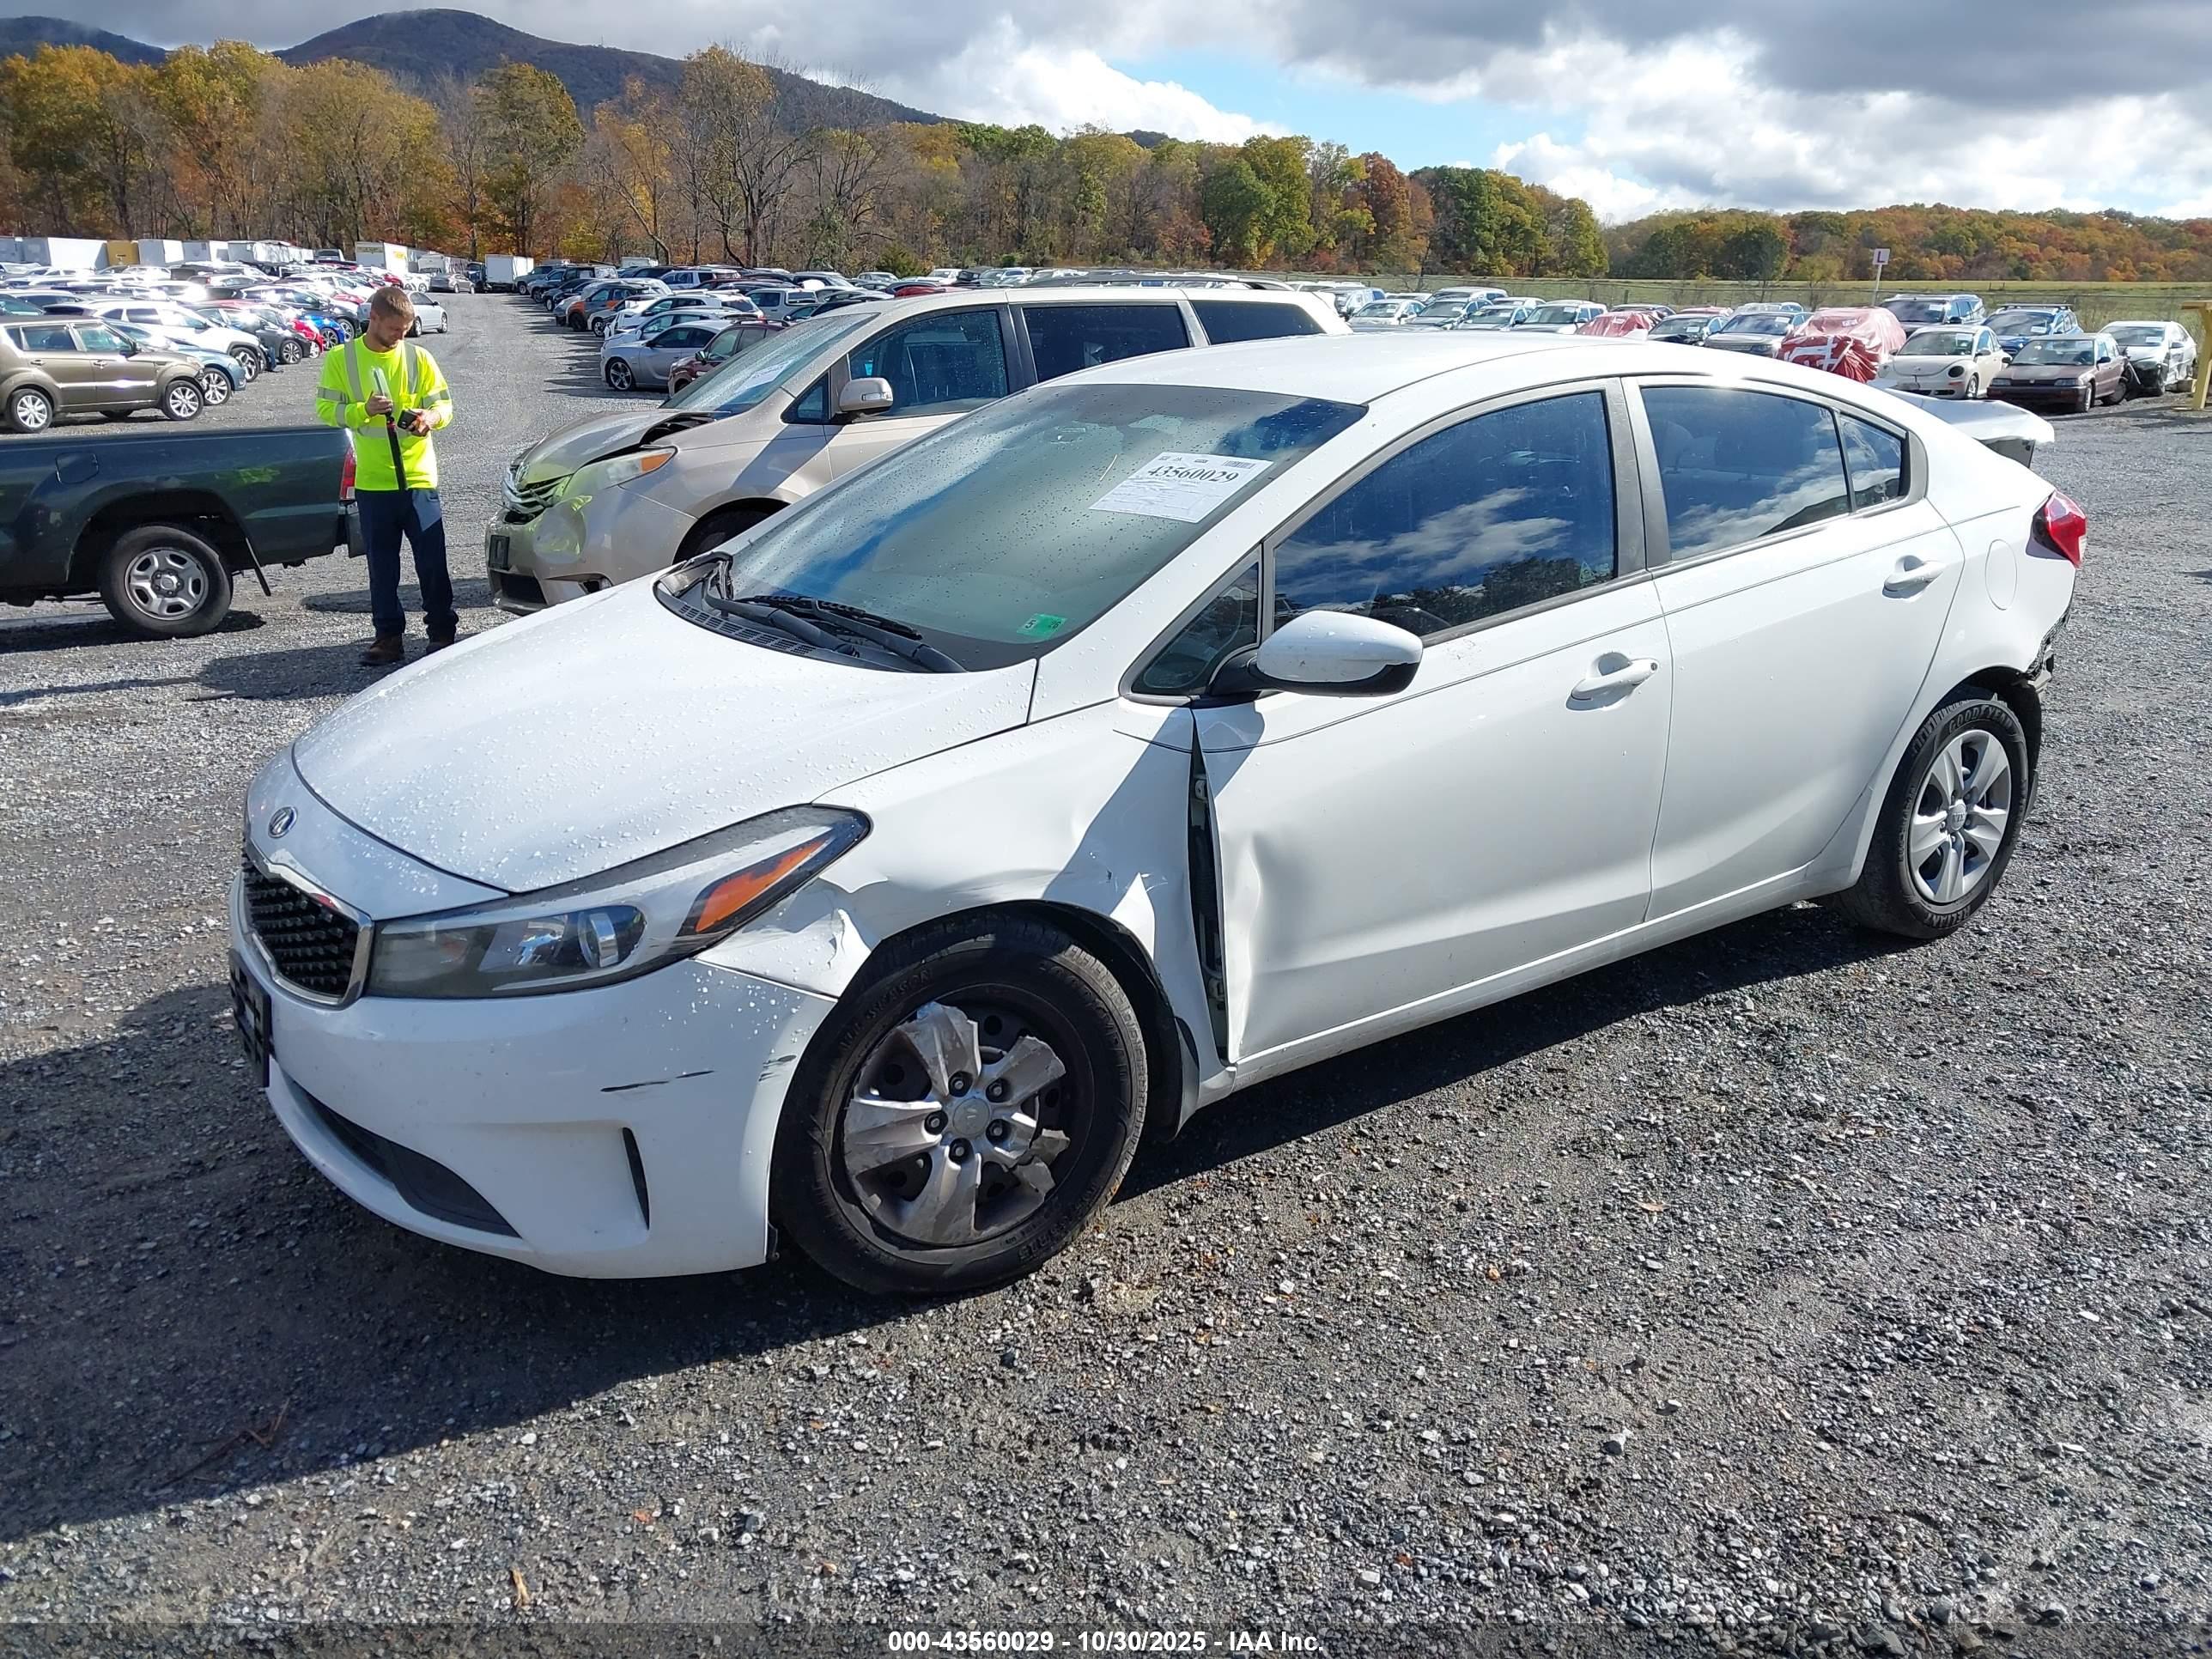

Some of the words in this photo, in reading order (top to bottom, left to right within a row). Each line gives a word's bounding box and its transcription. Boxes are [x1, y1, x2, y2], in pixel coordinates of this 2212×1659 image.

[1877, 251, 1887, 263] L
[1148, 465, 1239, 483] 43560029
[1948, 704, 2013, 734] GOODYEAR
